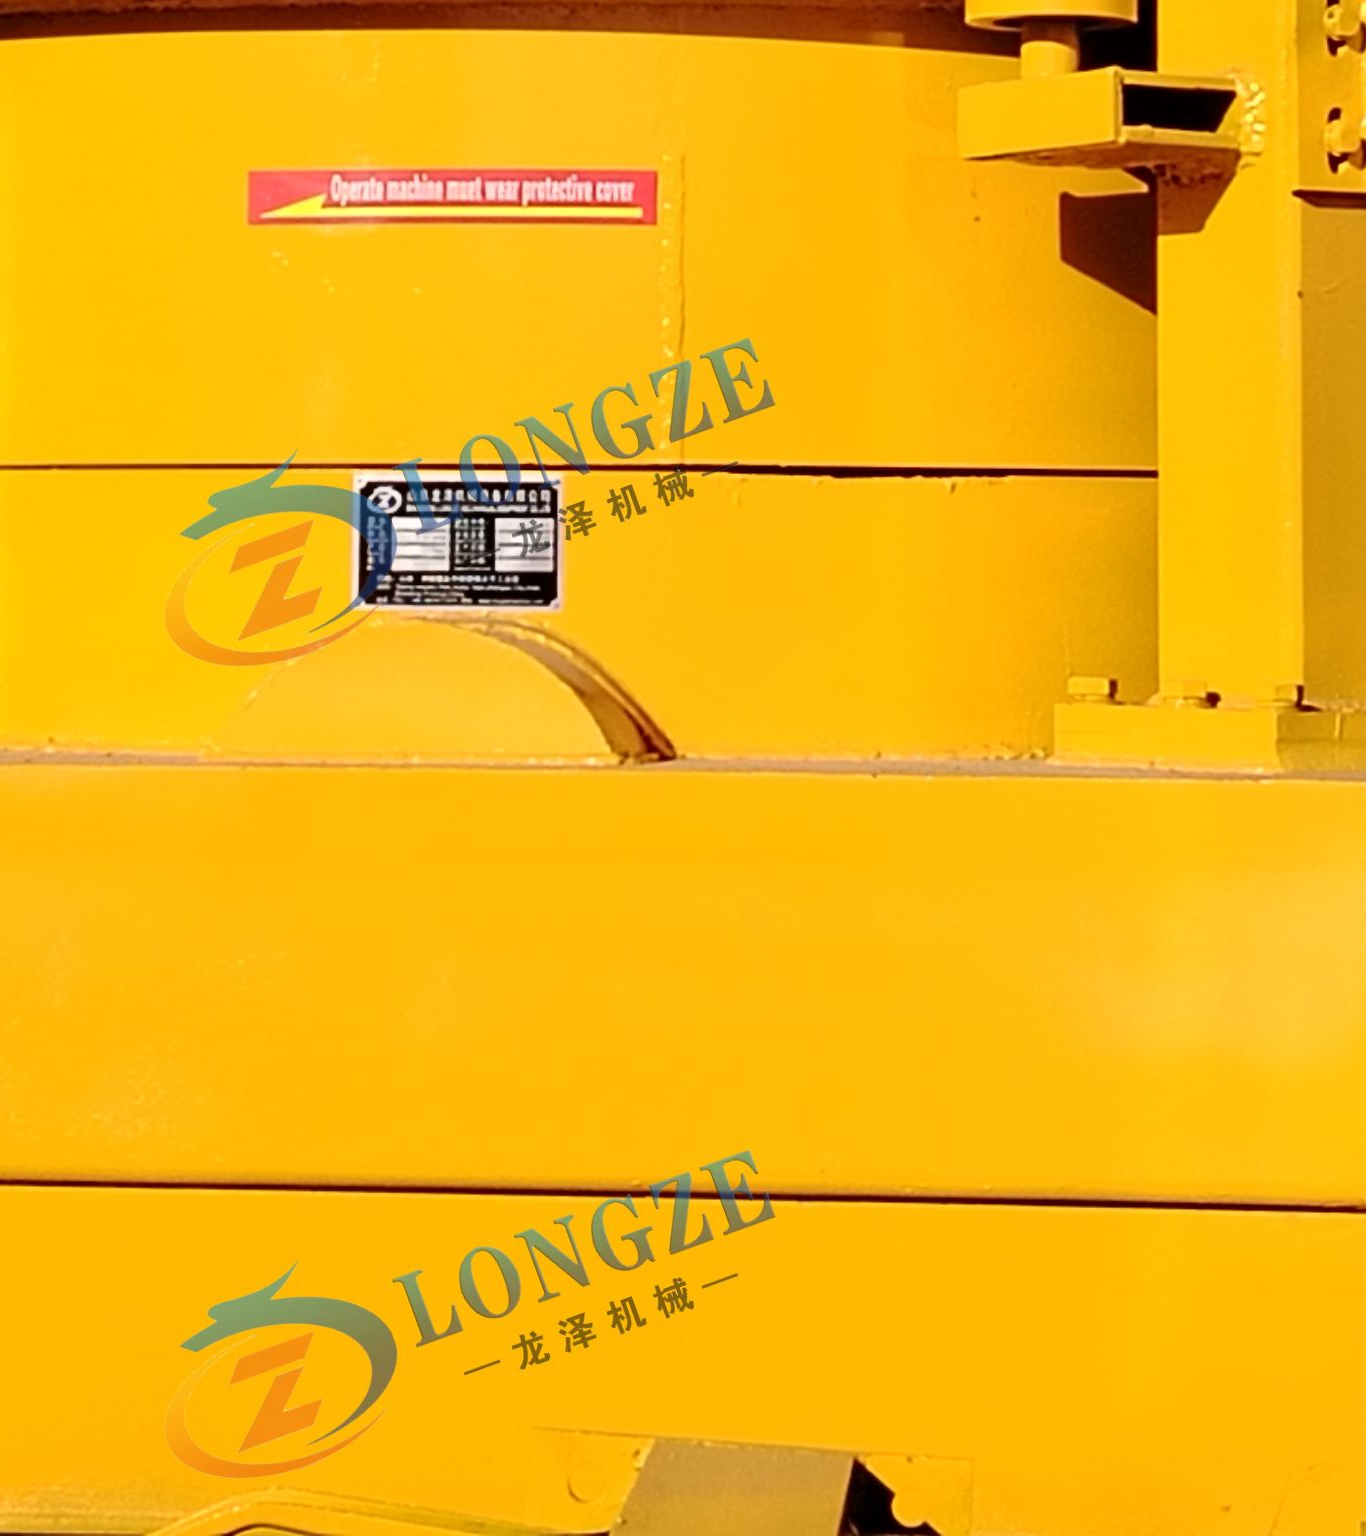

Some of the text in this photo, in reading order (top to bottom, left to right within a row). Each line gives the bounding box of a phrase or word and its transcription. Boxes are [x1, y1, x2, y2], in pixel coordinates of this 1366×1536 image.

[330, 173, 384, 207] Operate
[386, 173, 444, 202] machine
[485, 180, 520, 202] wear
[522, 174, 593, 207] protective
[595, 181, 635, 202] cover
